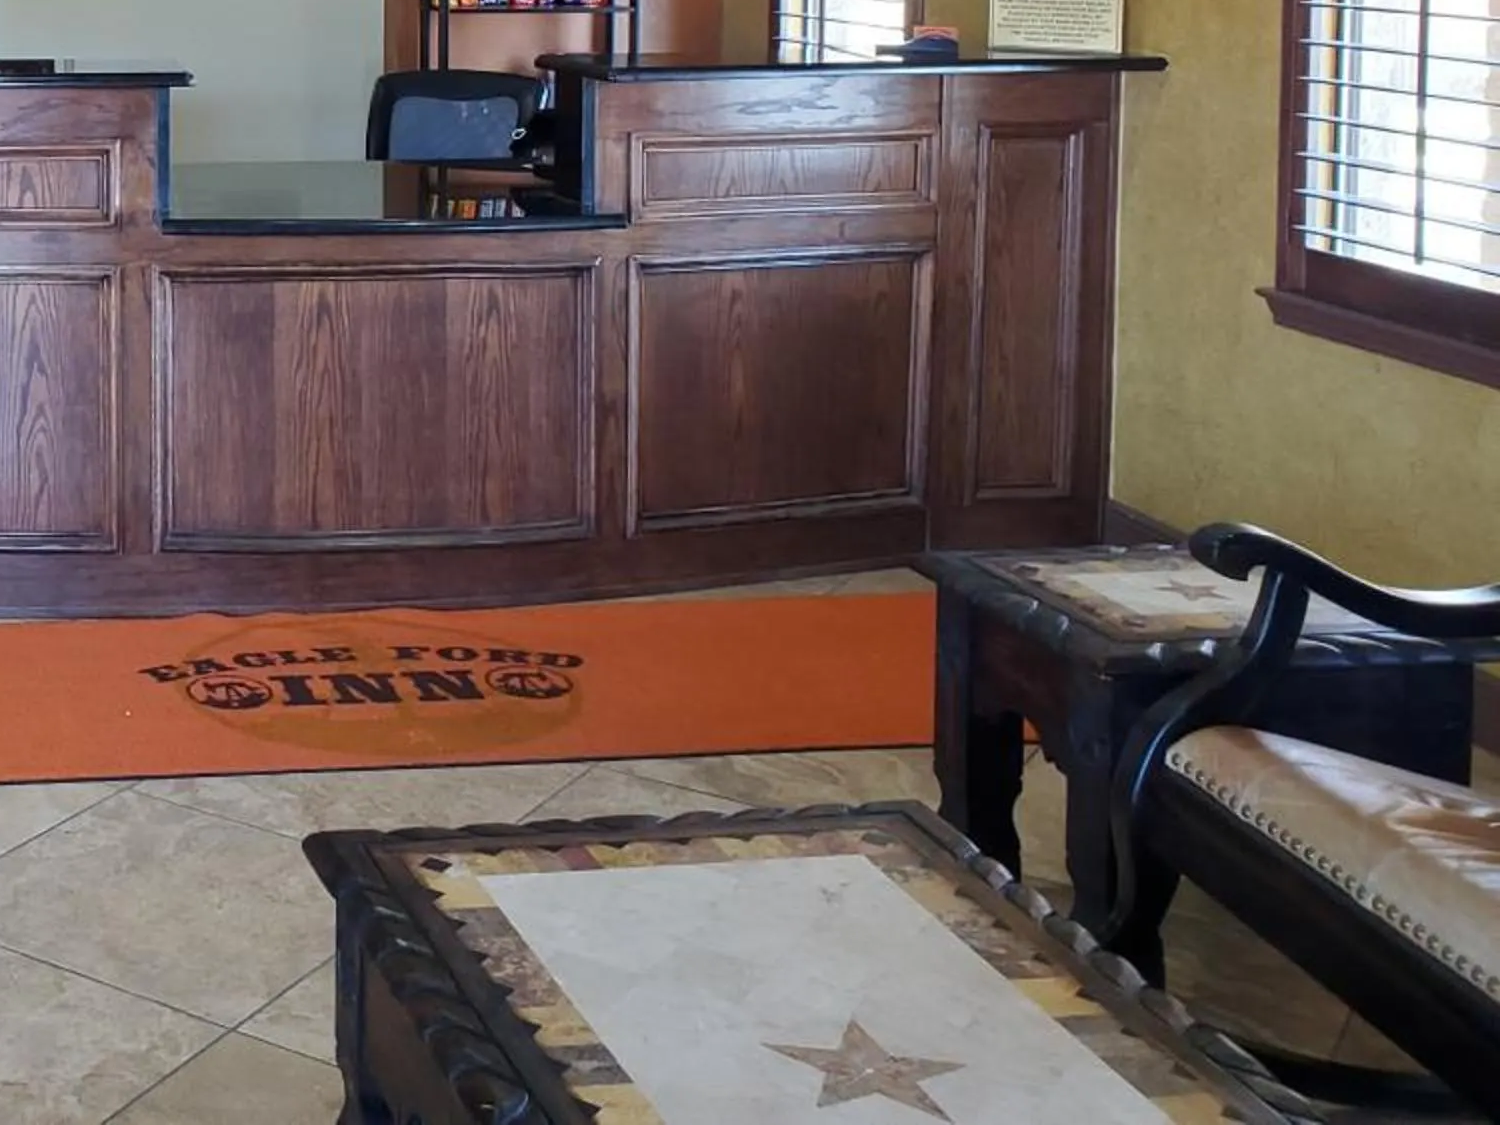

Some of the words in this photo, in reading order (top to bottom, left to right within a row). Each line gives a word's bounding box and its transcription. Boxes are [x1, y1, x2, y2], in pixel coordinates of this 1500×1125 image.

[138, 647, 357, 683] EAGLE
[387, 646, 584, 668] FORD
[268, 670, 486, 706] INN
